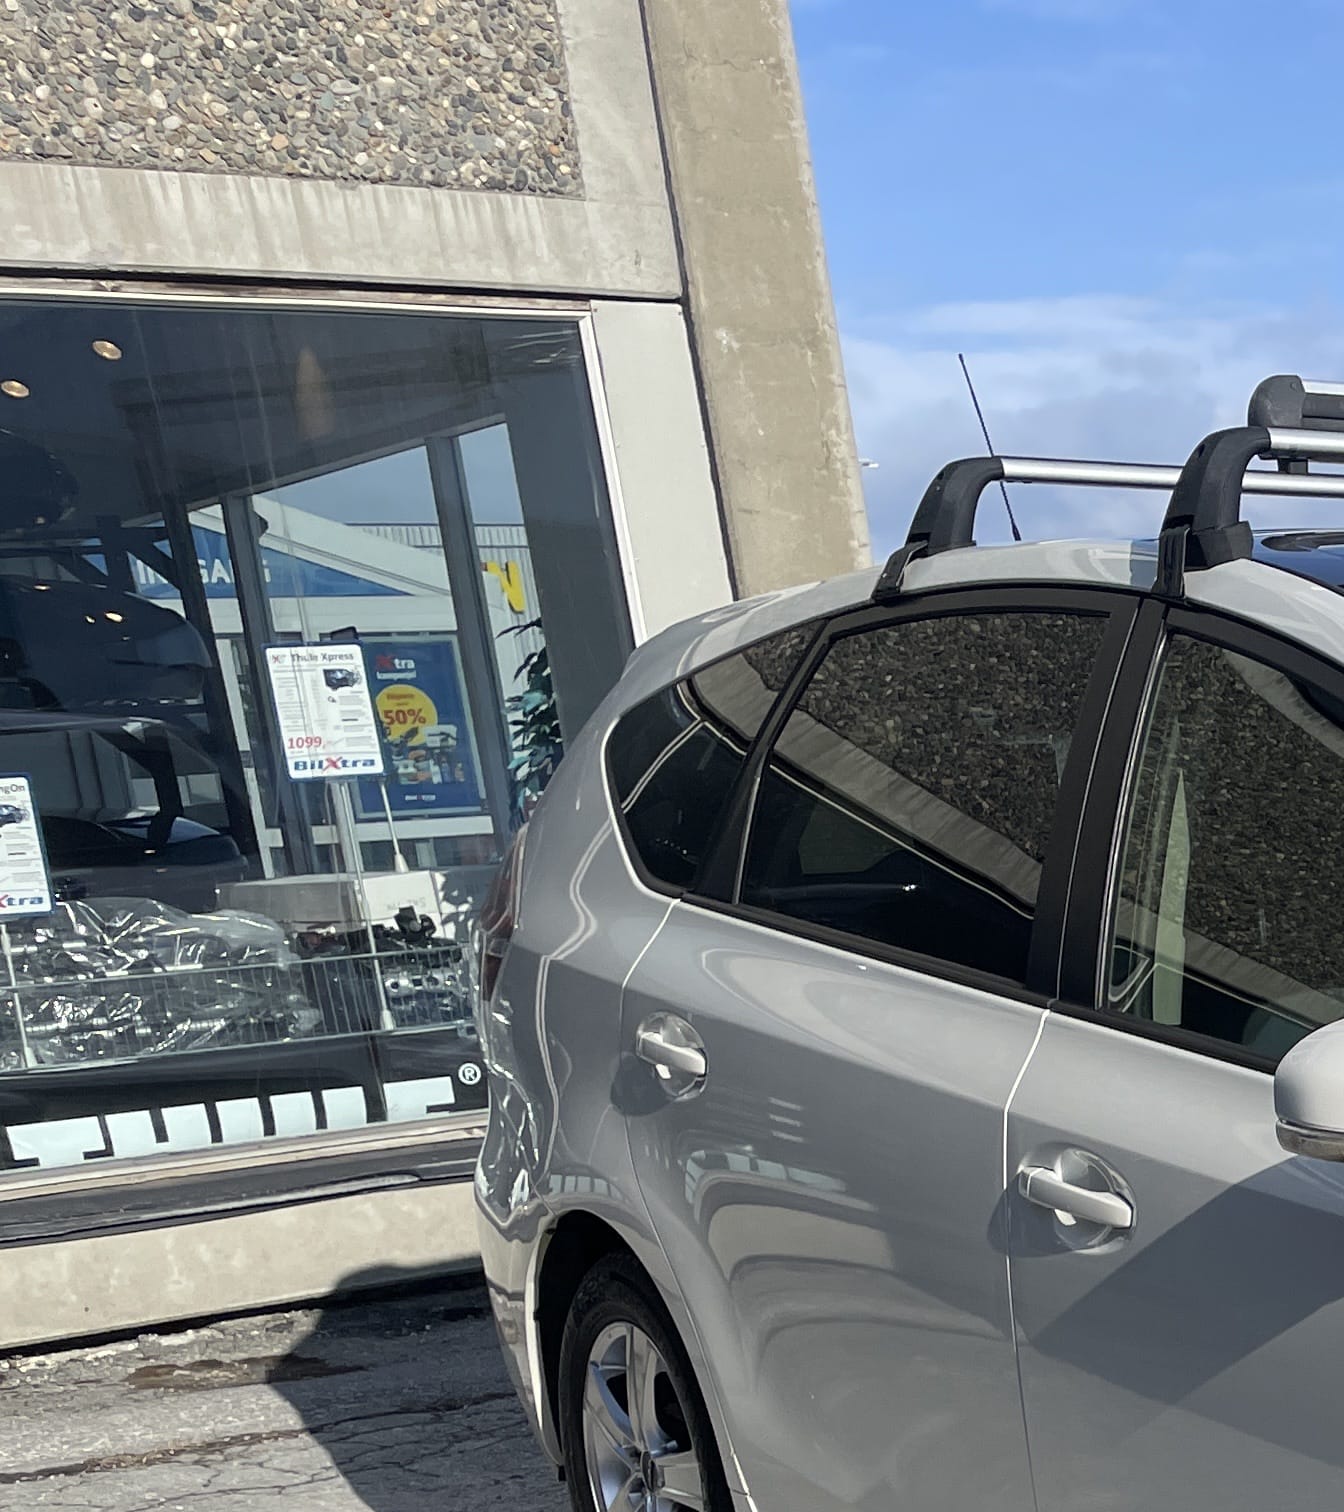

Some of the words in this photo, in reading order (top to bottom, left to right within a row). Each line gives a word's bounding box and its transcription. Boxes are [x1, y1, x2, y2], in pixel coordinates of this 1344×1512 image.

[321, 652, 354, 662] Xpress
[383, 709, 427, 725] 50%
[294, 756, 376, 774] BilXtra
